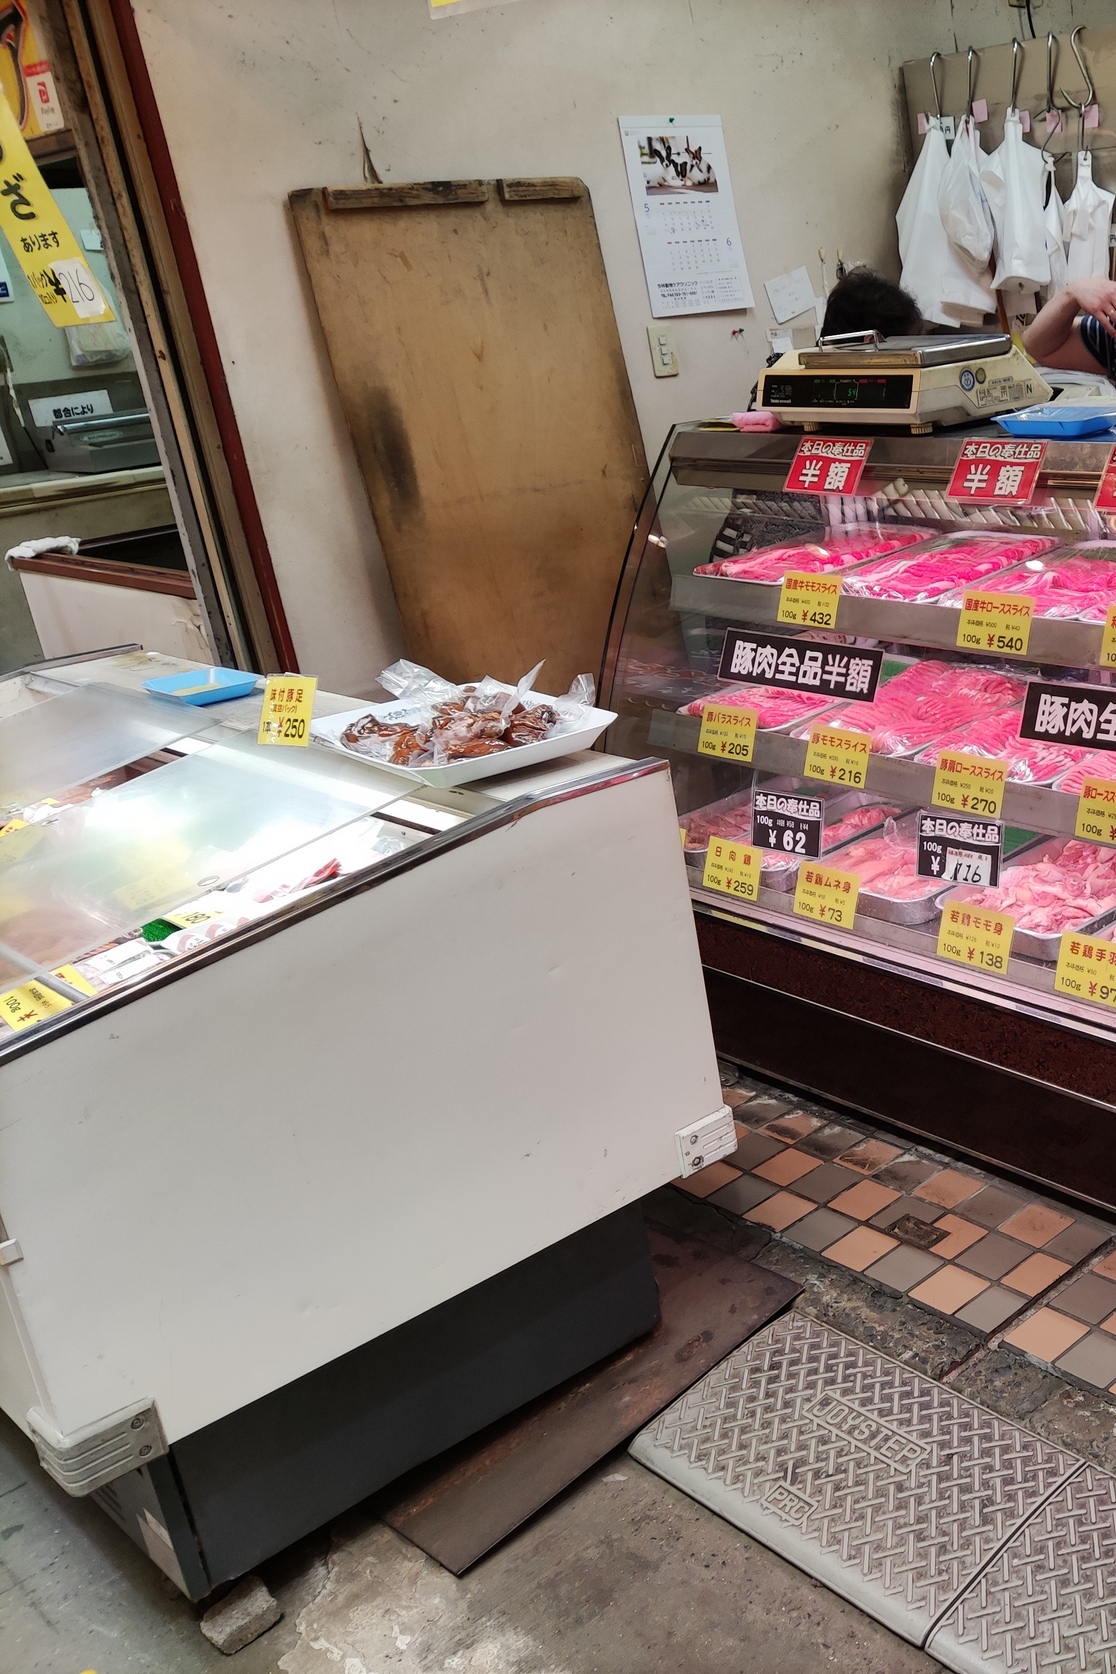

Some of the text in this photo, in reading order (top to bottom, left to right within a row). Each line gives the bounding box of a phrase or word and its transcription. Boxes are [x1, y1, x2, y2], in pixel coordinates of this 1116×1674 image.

[644, 204, 650, 213] 5
[20, 230, 60, 253] あります
[726, 237, 732, 247] 6
[801, 440, 866, 458] 本日の奉仕品
[964, 441, 1041, 460] 本日の奉仕品
[798, 459, 851, 491] 半額
[963, 463, 1025, 497] 半額
[785, 578, 837, 595] 国産牛モモスライス
[782, 609, 832, 626] 100g ¥432
[965, 599, 1030, 617] 国産牛ローススライス
[962, 633, 1023, 651] 100g ¥540
[730, 640, 873, 693] 豚肉全品半額
[270, 688, 303, 703] 味付豚足
[278, 717, 305, 738] ¥250
[702, 741, 748, 756] 100g ¥205
[812, 733, 867, 753] 豚モモスライス
[809, 764, 861, 783] 100g ¥216
[940, 758, 1003, 781] 豚肩ローススライス
[755, 794, 820, 817] 本日の奉仕品
[937, 792, 996, 814] 100g ¥270
[757, 815, 773, 827] 100g
[921, 817, 1000, 843] 本日の奉仕品
[1081, 823, 1102, 836] 100g
[769, 830, 806, 853] ¥62
[923, 841, 942, 854] 100g
[707, 874, 754, 896] 100g ¥259
[805, 871, 851, 893] 若鶏ムネ身
[798, 902, 842, 922] 100g ¥73
[950, 910, 1003, 935] 若鶏モモ身
[943, 943, 1003, 969] 100g ¥138
[1061, 976, 1081, 991] 100g
[812, 1400, 922, 1465] JOYSTEP
[767, 1489, 811, 1520] PRC
